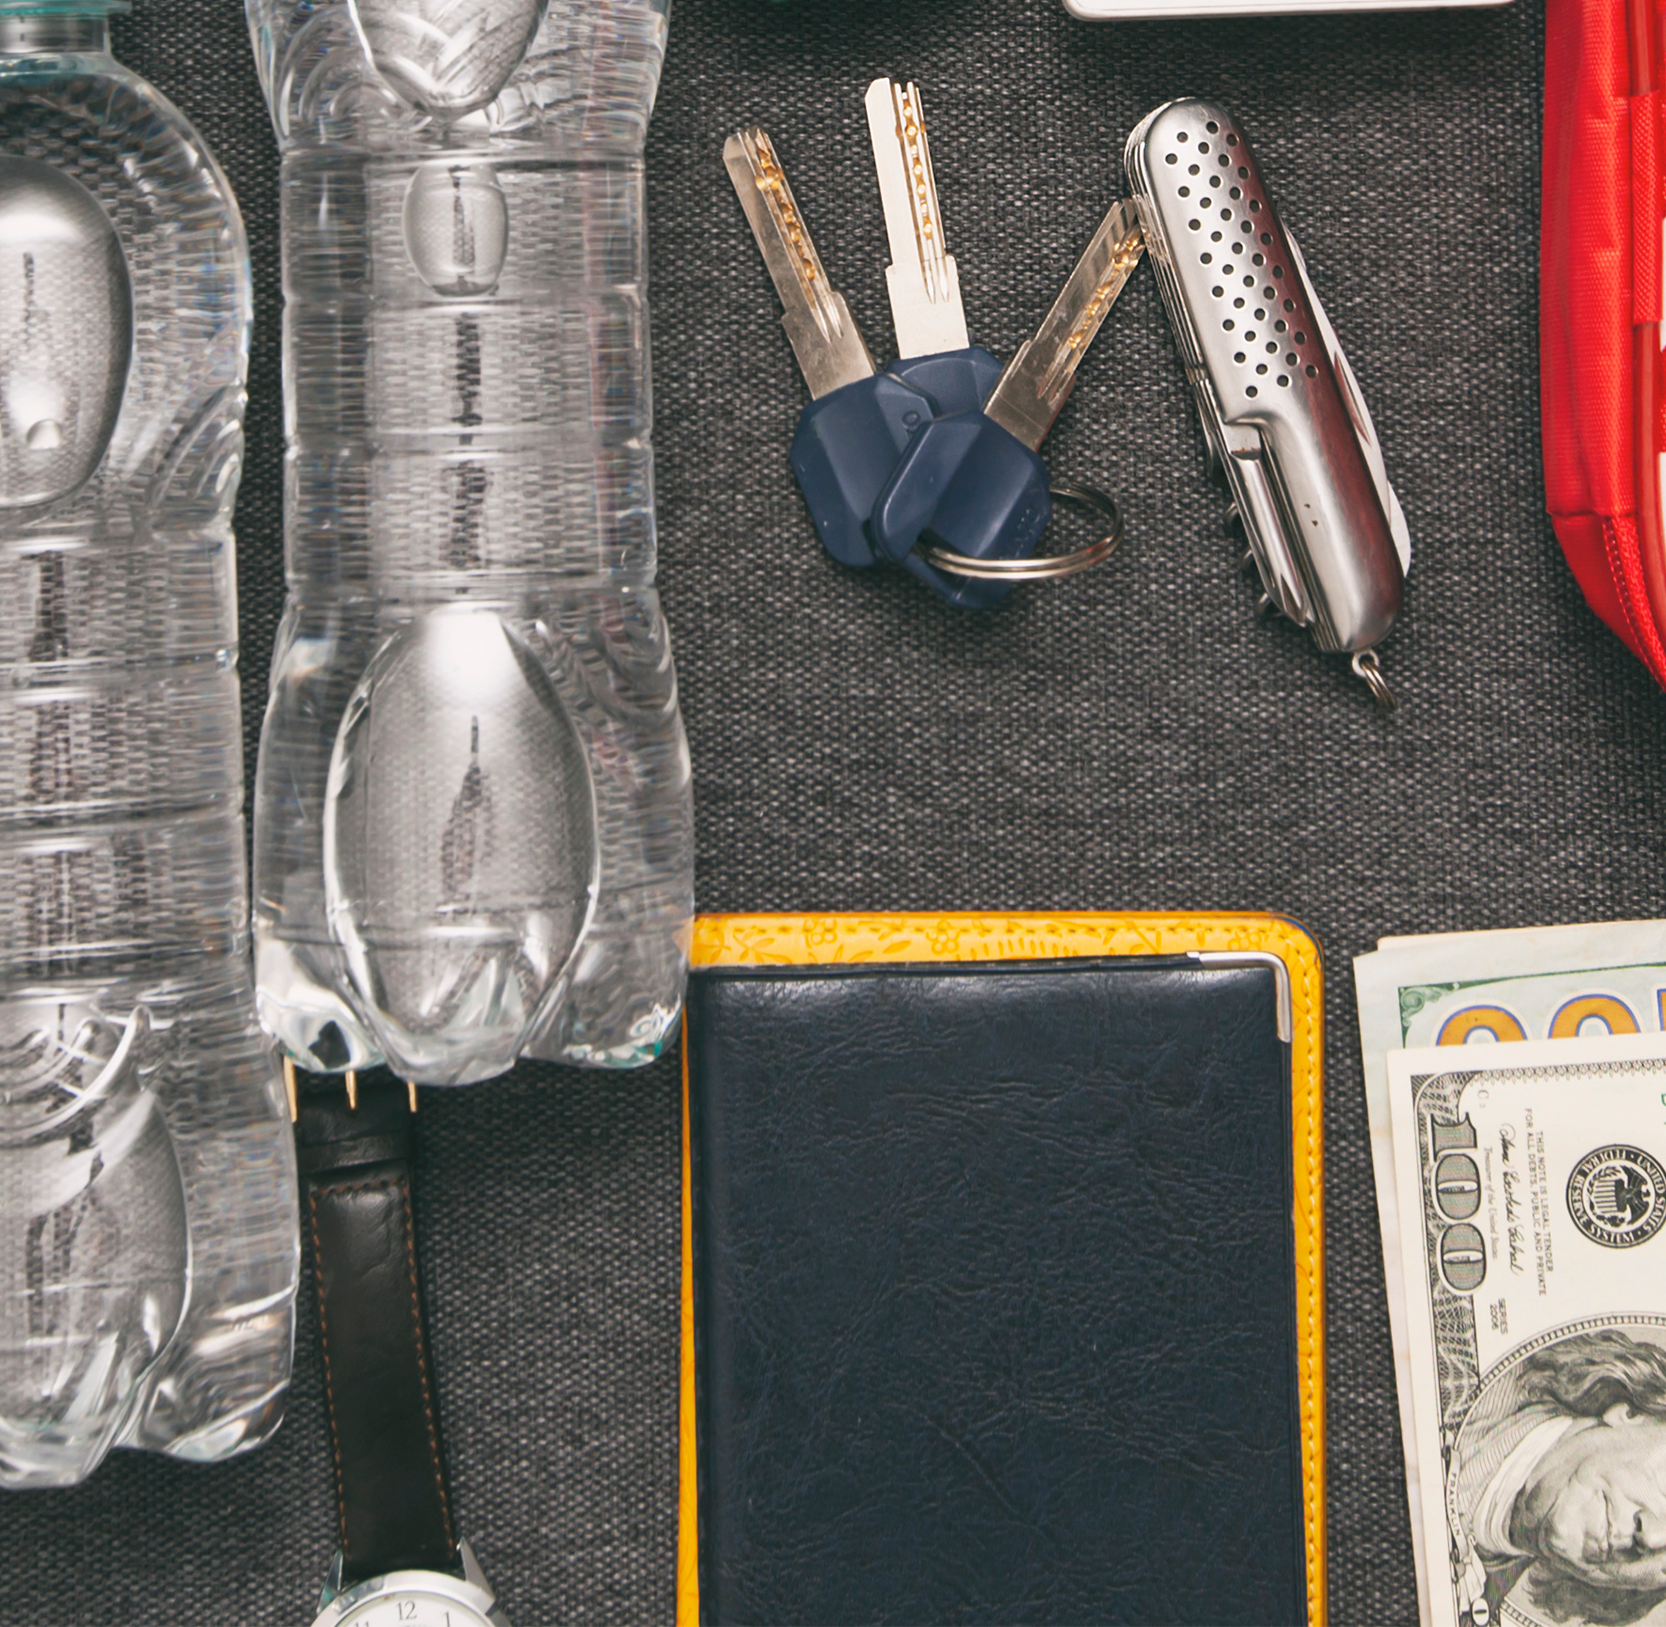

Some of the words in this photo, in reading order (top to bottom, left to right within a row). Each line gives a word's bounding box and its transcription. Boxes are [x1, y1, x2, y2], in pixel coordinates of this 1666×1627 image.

[1525, 1109, 1534, 1128] FOR
[1527, 1132, 1536, 1150] ALL
[1536, 1131, 1544, 1153] THIS
[1538, 1157, 1546, 1183] NOTE
[1637, 1156, 1666, 1193] UNITED
[1430, 1112, 1488, 1293] 100
[1540, 1186, 1547, 1195] IS
[1572, 1175, 1589, 1225] RESERVE
[1531, 1192, 1541, 1229] PUBLIC
[1540, 1198, 1550, 1230] LEGAL
[1642, 1196, 1666, 1232] STATES
[1533, 1232, 1543, 1252] AND
[1544, 1232, 1553, 1272] TENDER
[1536, 1256, 1546, 1296] PRIVATE
[1490, 1304, 1499, 1330] 2006
[1498, 1298, 1508, 1335] SERIES
[1448, 1472, 1461, 1537] FRANKLIN
[395, 1600, 418, 1621] 12
